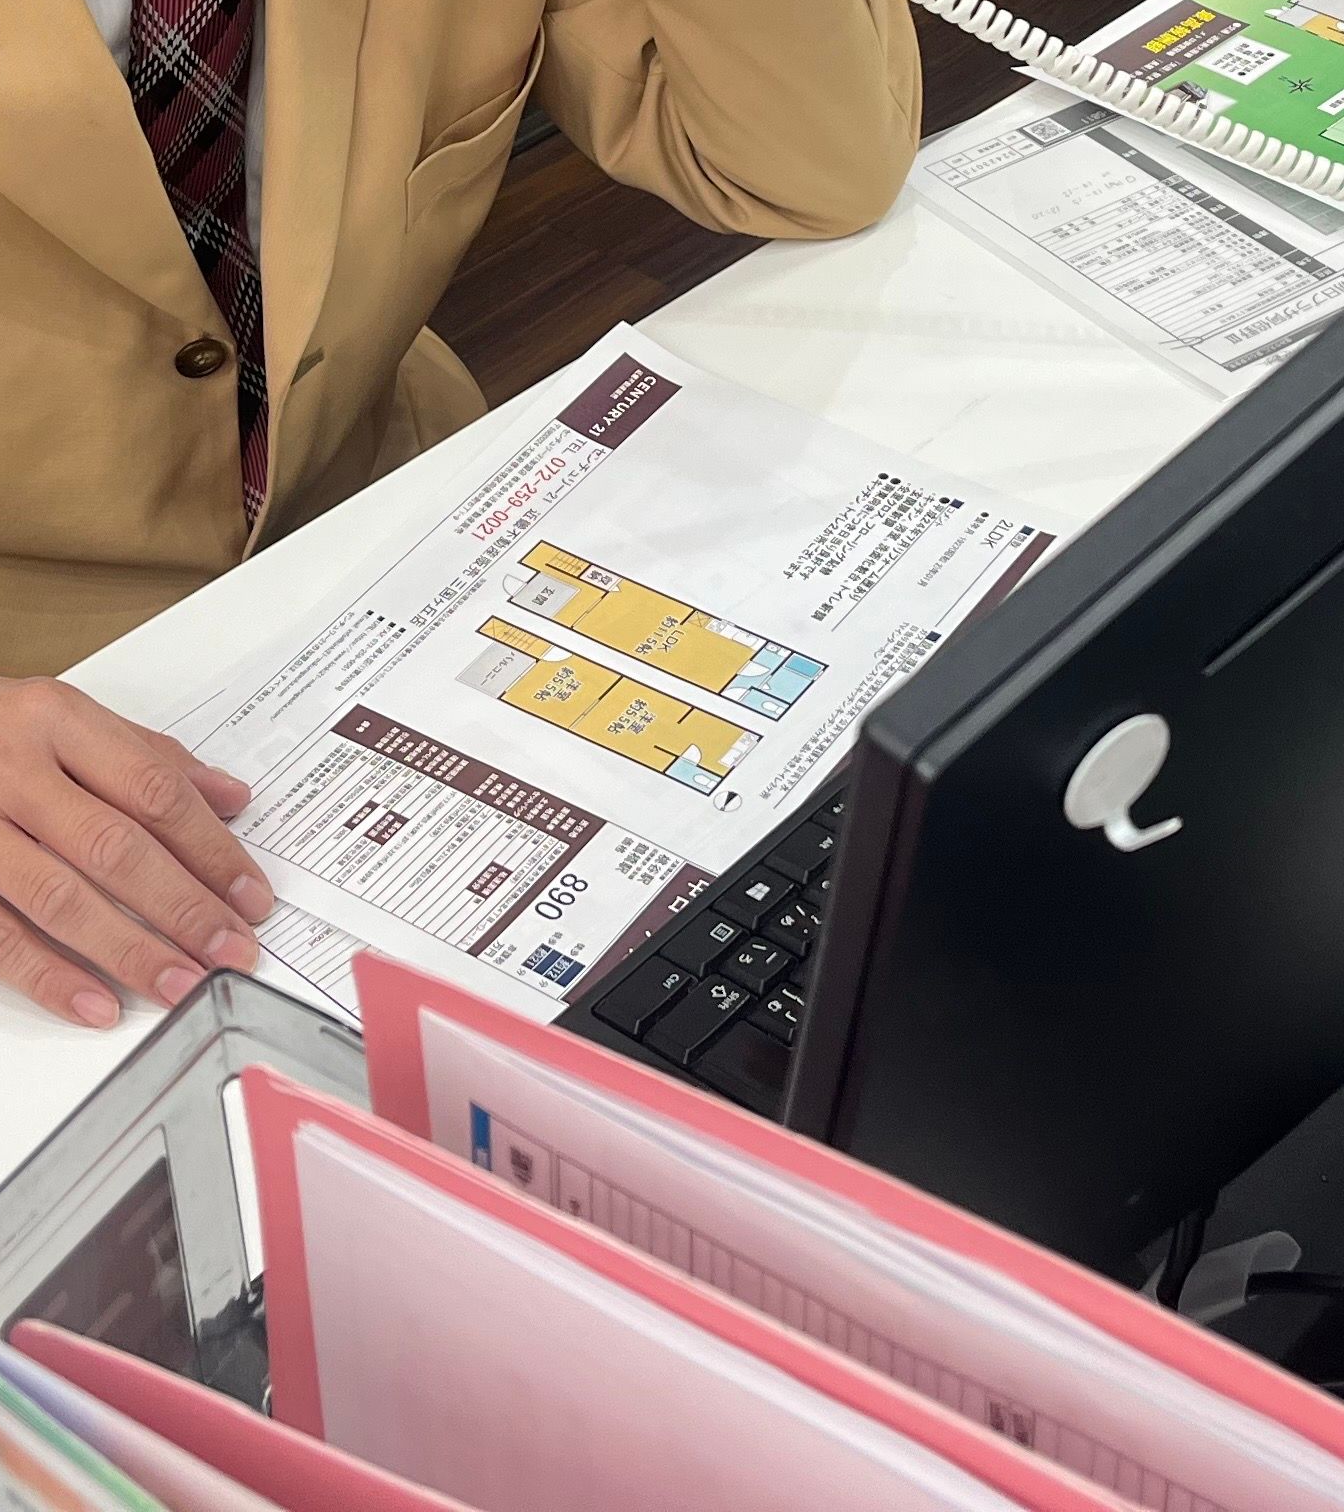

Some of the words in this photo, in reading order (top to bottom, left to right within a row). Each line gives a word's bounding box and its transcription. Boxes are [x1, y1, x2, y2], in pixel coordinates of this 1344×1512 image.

[1142, 10, 1217, 53] 最高報酬額
[599, 374, 658, 424] CENTURY
[587, 423, 607, 436] 21
[539, 446, 607, 503] センチュリー21
[468, 456, 568, 541] 072-259-0021
[462, 507, 541, 578] 近畿不動産販売
[979, 519, 1014, 548] 2LDK
[408, 577, 468, 627] 三国ヶ丘店
[530, 585, 556, 605] 玄関
[657, 629, 685, 653] LDK
[477, 651, 518, 686] バルコニー
[553, 678, 582, 701] 洋室
[625, 710, 656, 734] 洋室
[529, 872, 592, 921] 890
[661, 971, 680, 990] Ctrl
[715, 988, 740, 1011] Shift
